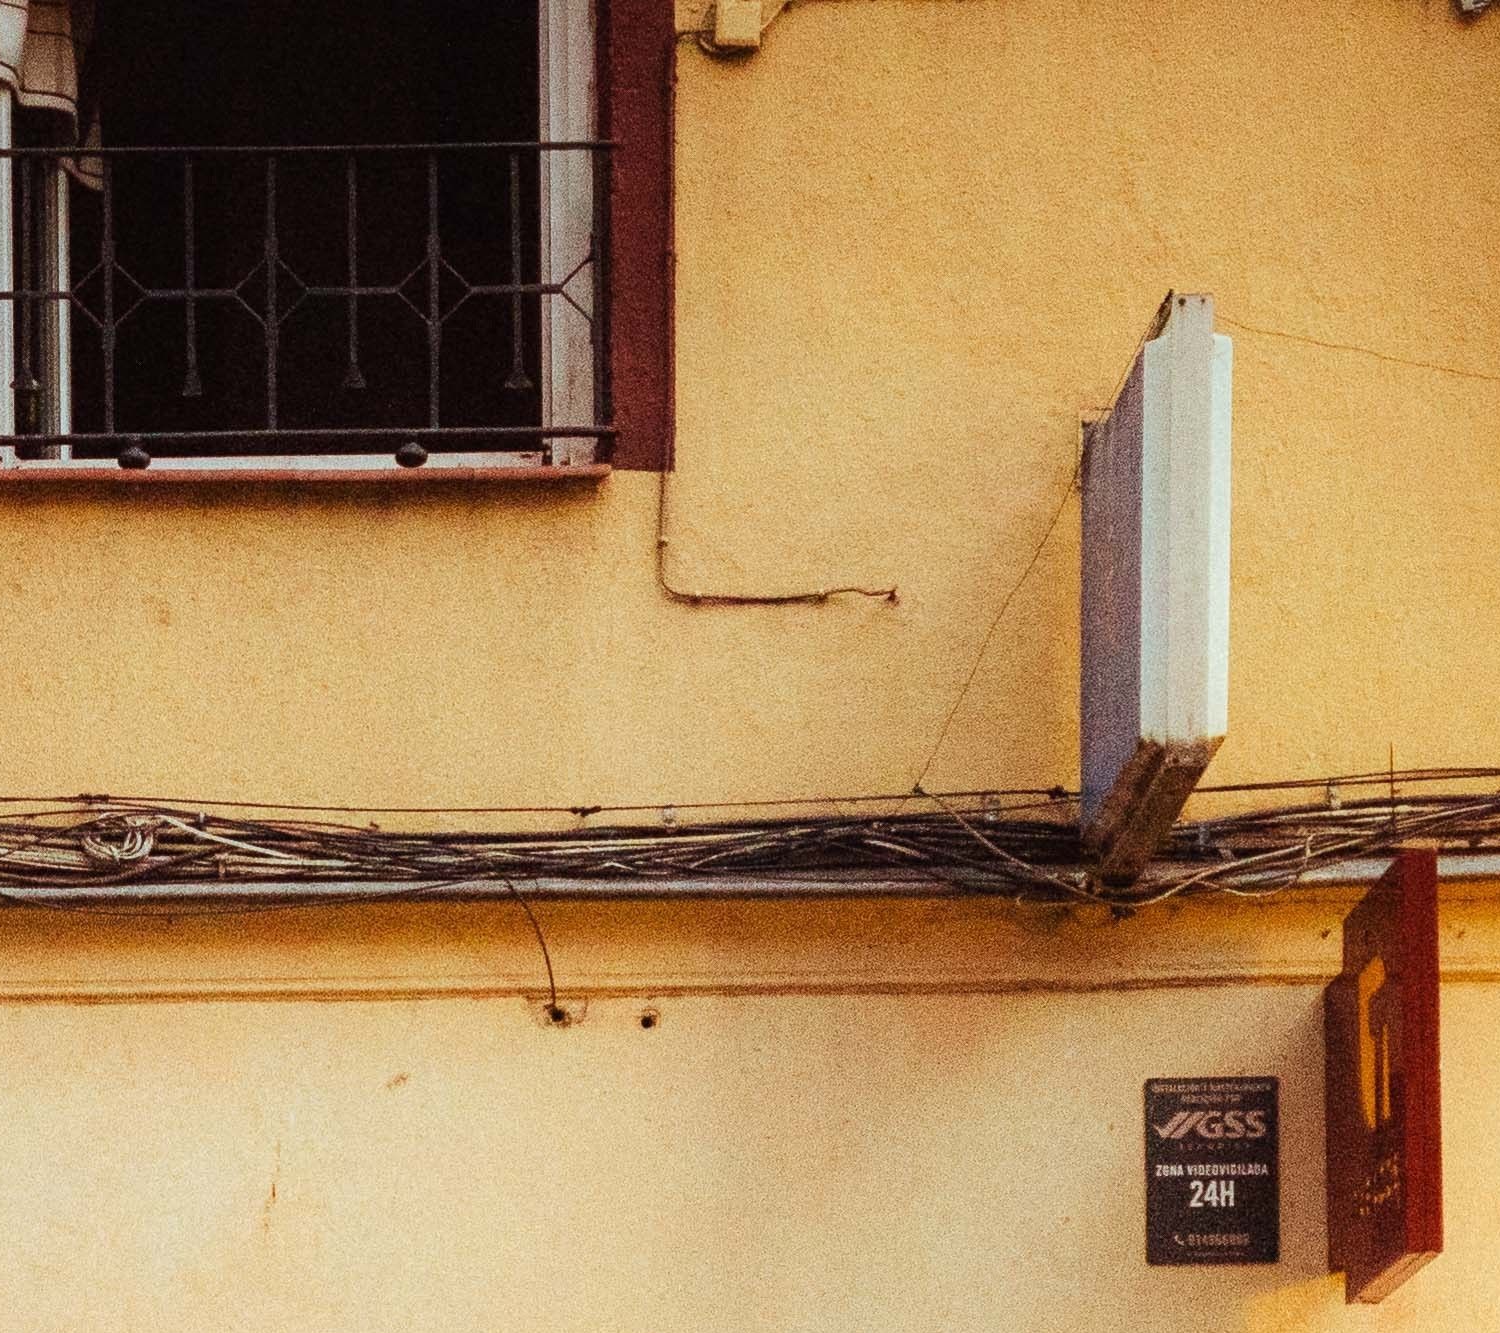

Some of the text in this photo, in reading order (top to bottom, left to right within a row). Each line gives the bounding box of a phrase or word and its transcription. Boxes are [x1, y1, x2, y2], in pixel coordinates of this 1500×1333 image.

[1155, 1163, 1269, 1177] ZONA VIDEOVIGILADA
[1189, 1179, 1236, 1208] 24H
